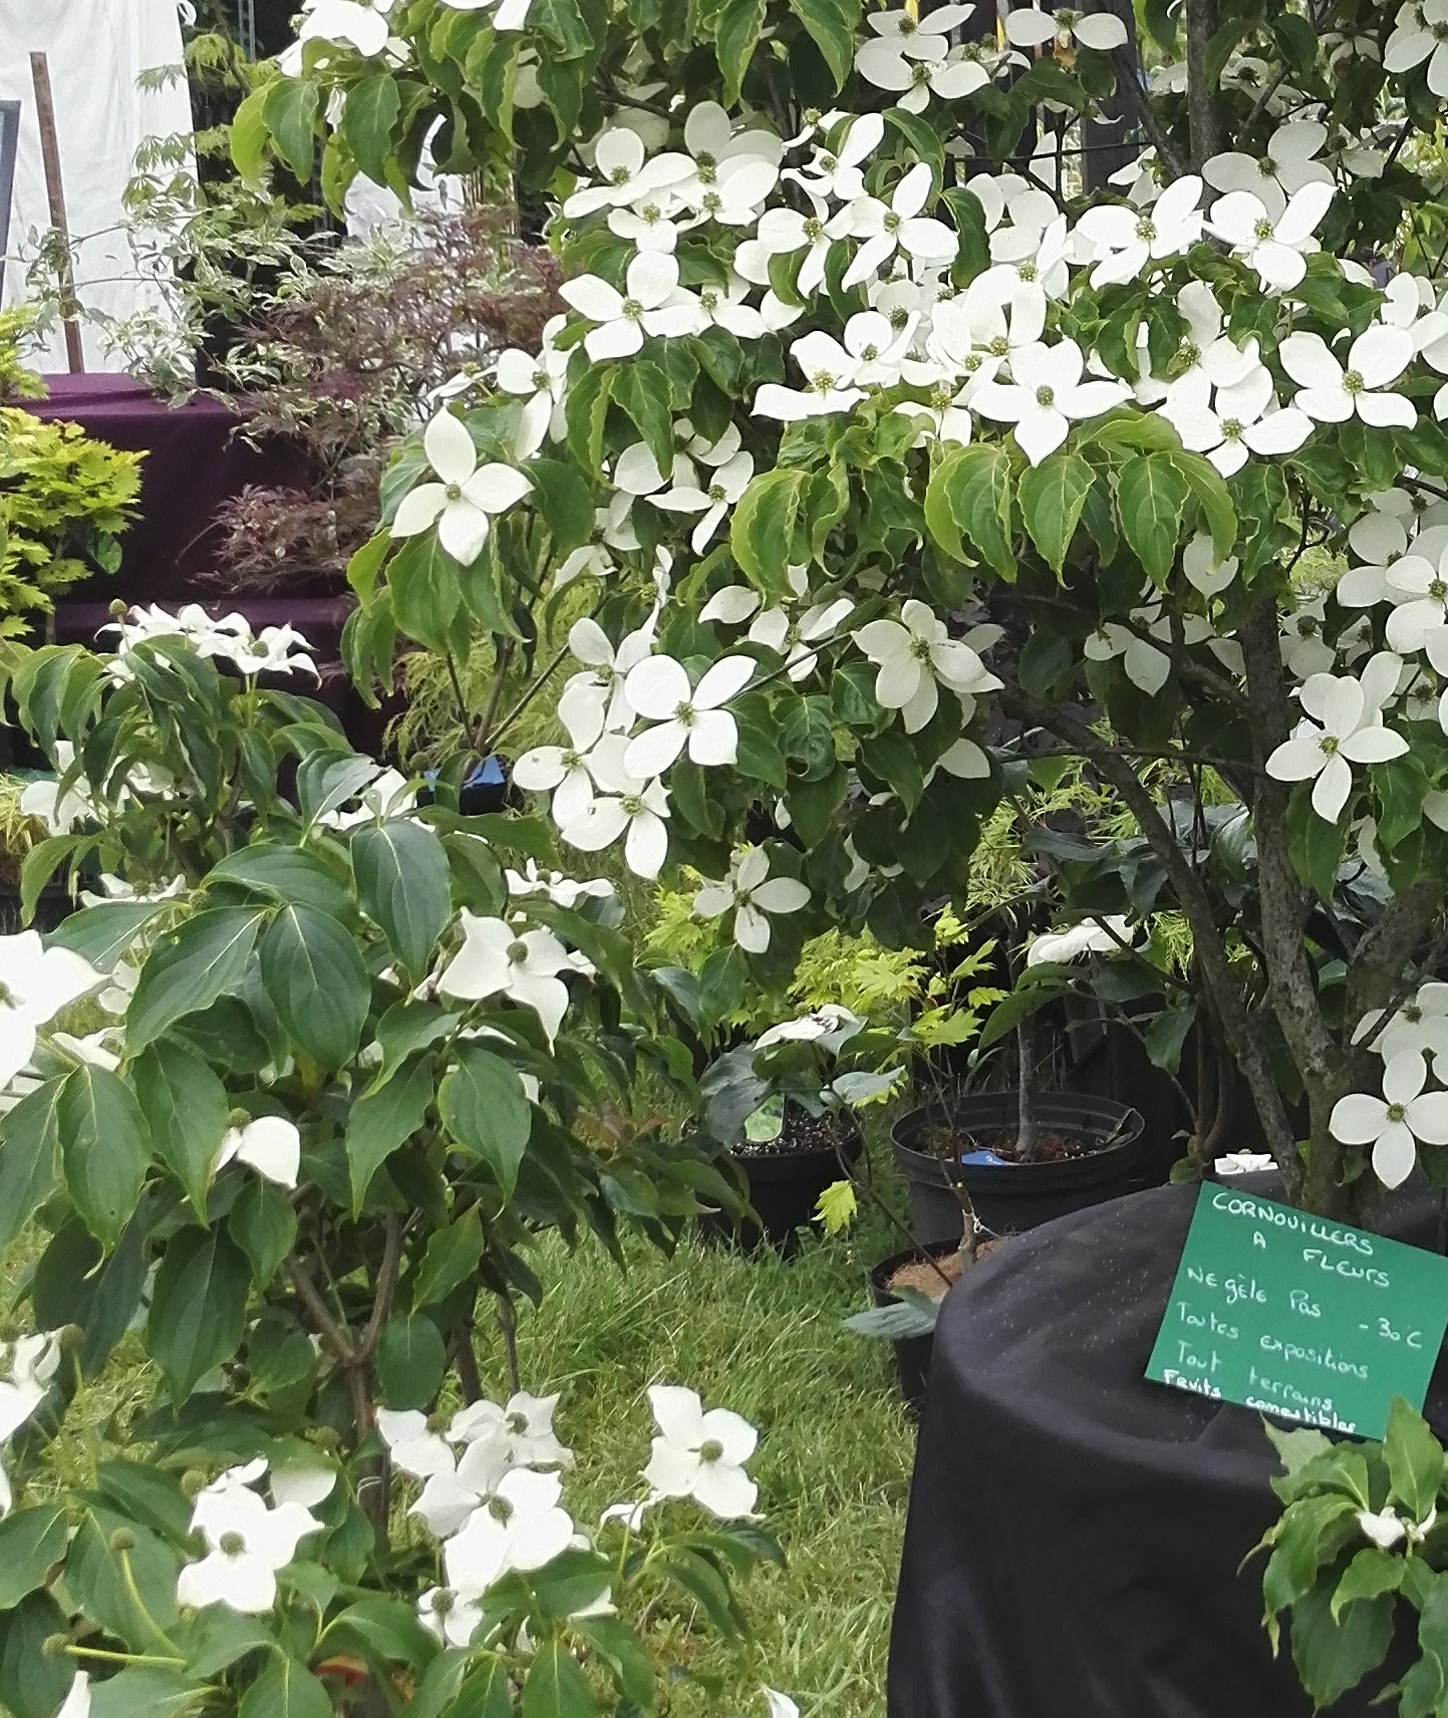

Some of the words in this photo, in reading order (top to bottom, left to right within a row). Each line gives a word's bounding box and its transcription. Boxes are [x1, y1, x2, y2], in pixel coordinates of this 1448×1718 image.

[1252, 1231, 1267, 1250] A
[1176, 1301, 1239, 1340] Toutes
[1259, 1334, 1369, 1379] expositions
[1178, 1339, 1223, 1373] Tout
[1249, 1365, 1333, 1411] terrains
